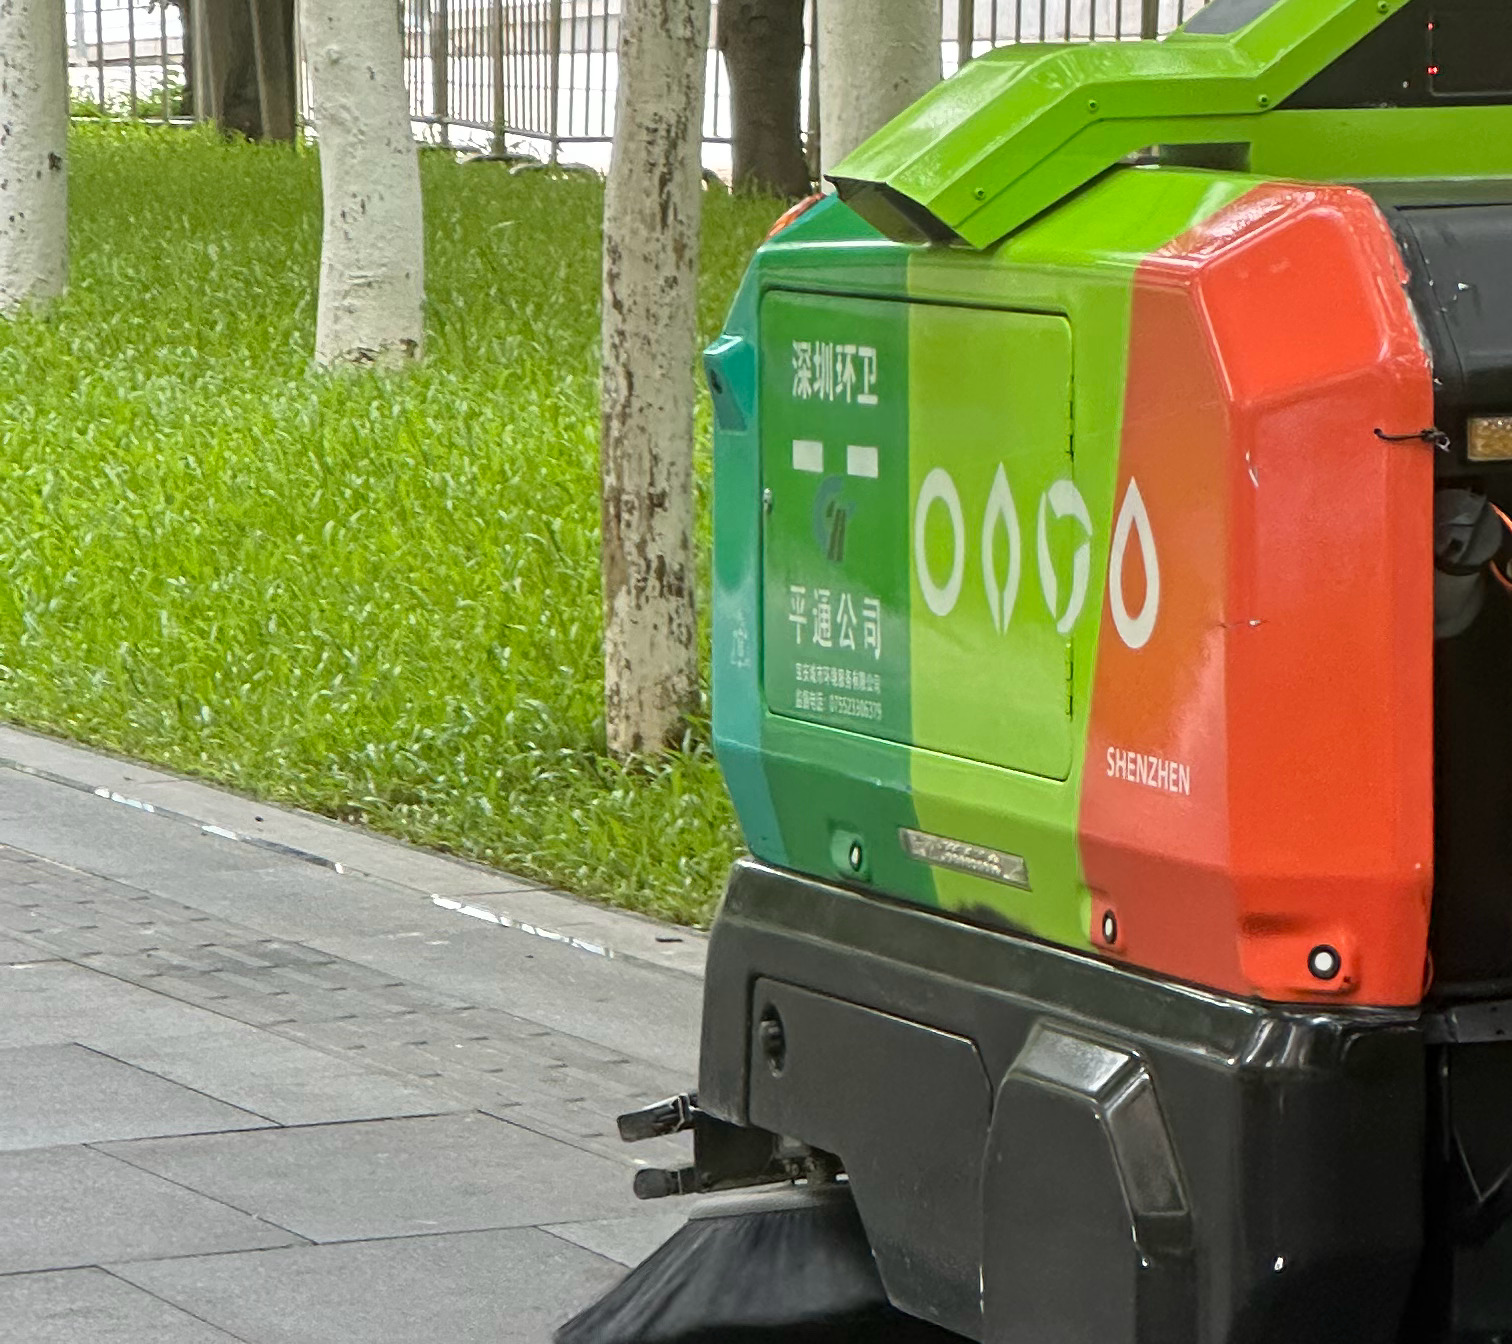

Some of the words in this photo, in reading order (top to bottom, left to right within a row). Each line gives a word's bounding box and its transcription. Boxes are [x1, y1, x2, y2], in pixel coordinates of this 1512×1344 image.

[792, 339, 878, 405] 深圳环卫
[788, 585, 881, 660] 平通公司
[1106, 746, 1190, 796] SHENZHEN
